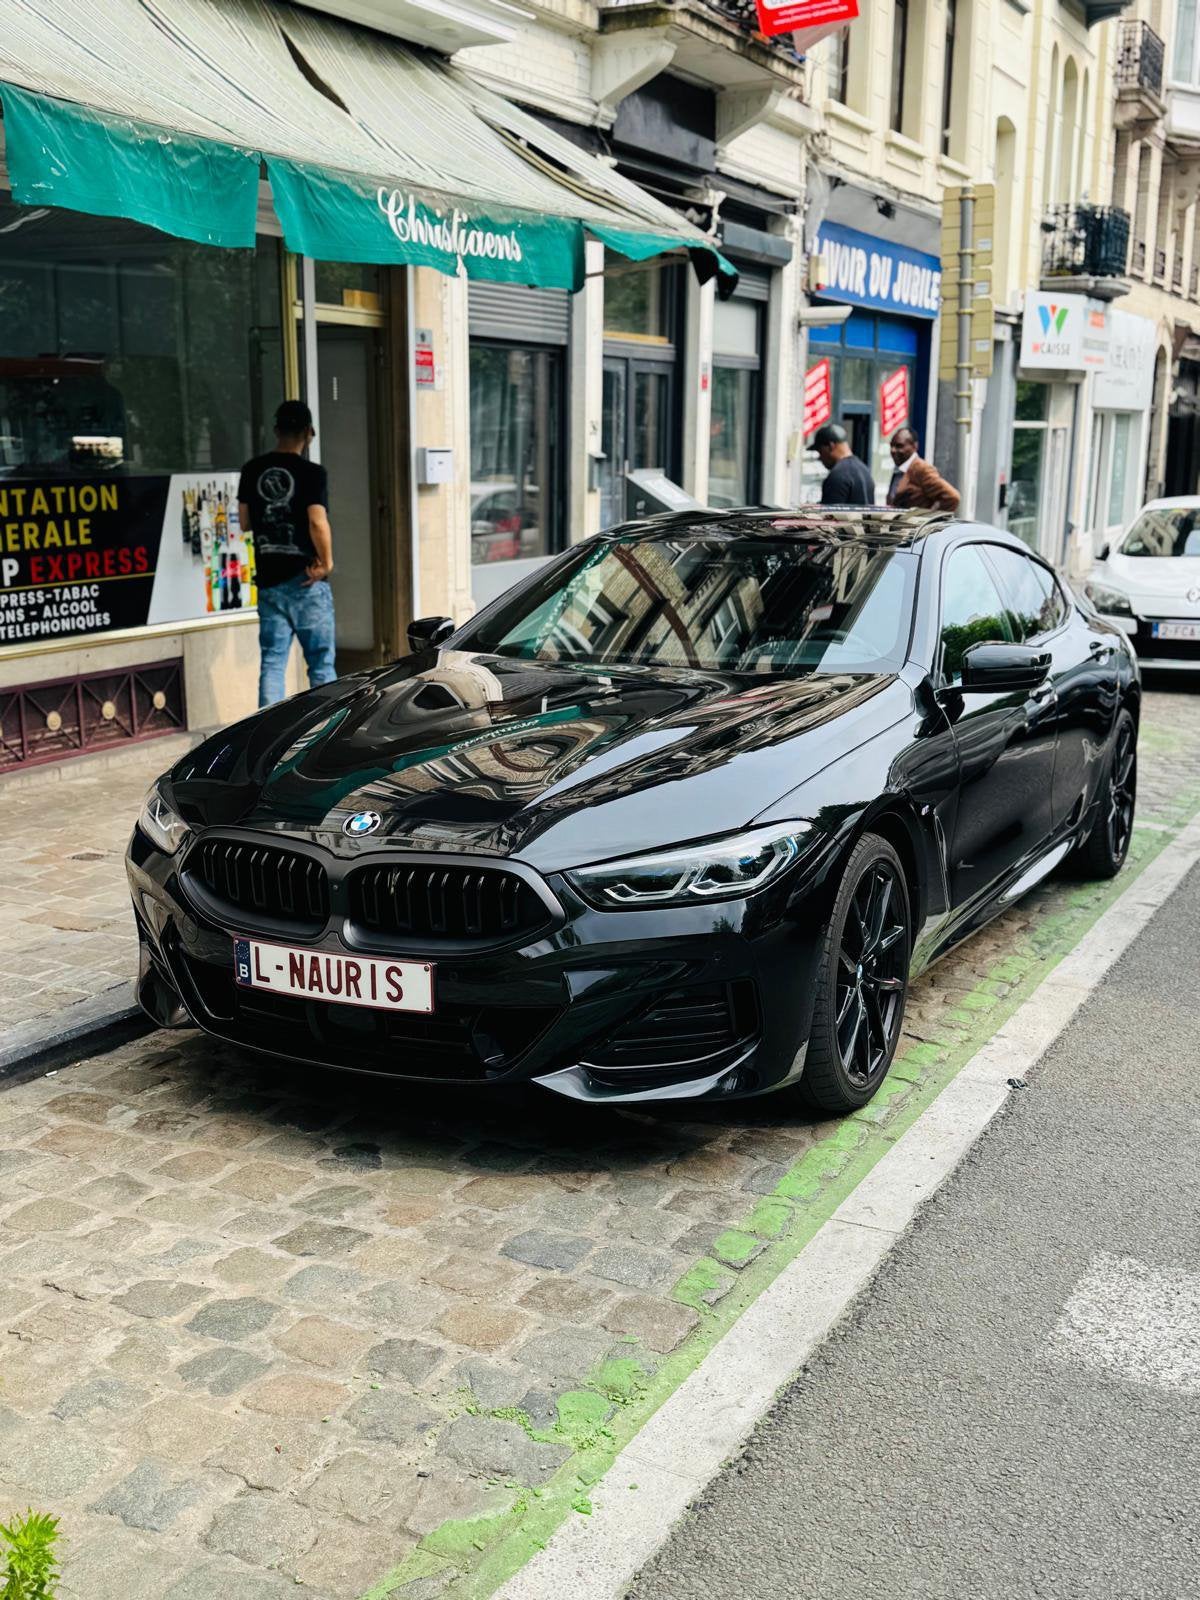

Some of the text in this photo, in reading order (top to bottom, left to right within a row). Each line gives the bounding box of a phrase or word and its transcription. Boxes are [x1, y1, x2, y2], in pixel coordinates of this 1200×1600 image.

[377, 186, 522, 262] Christiaens
[869, 252, 893, 300] DU
[0, 518, 92, 552] ERALE
[2, 546, 149, 587] P EXPRESS
[0, 584, 100, 608] PRESS-TABAC
[43, 600, 98, 619] ALCOOL
[0, 612, 111, 640] TELEPHONIQUES
[239, 946, 404, 1003] B L-NAURIS
